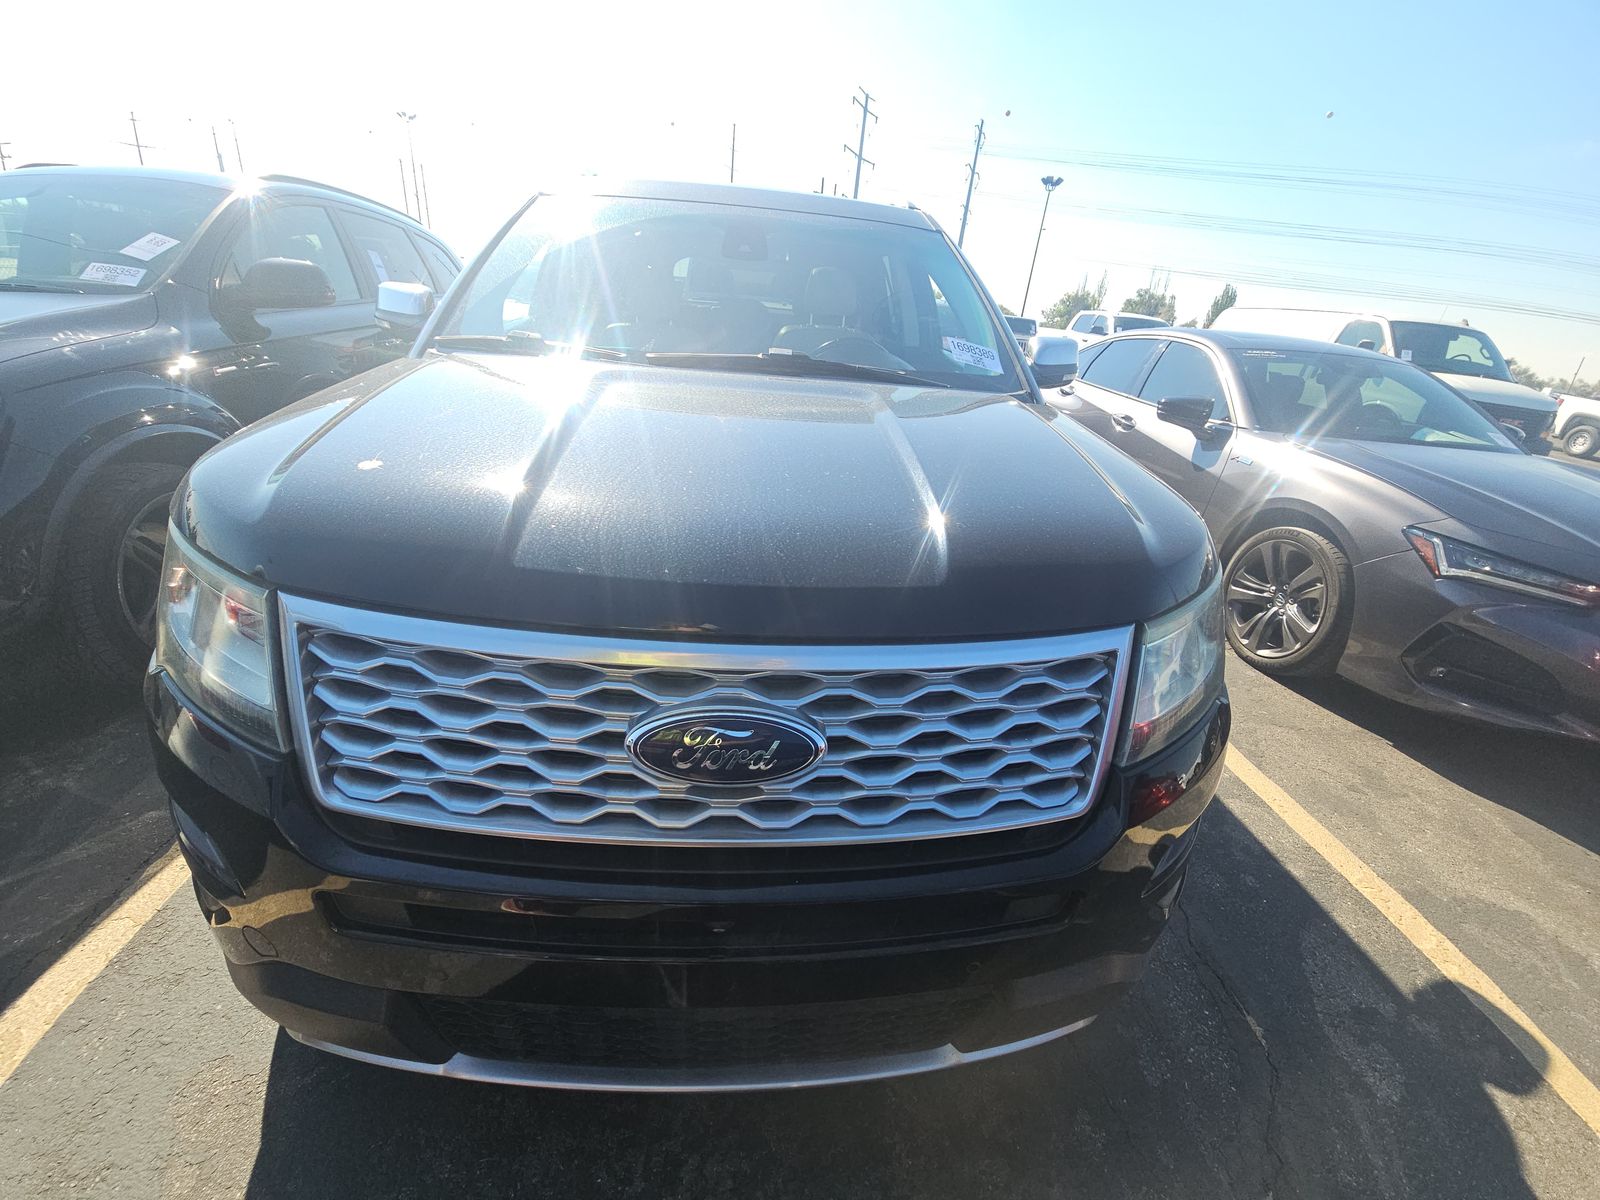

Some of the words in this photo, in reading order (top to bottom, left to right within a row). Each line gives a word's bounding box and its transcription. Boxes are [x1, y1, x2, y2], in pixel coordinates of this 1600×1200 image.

[91, 265, 140, 277] 1698352
[952, 340, 995, 361] 1698389
[671, 726, 780, 771] Ford
